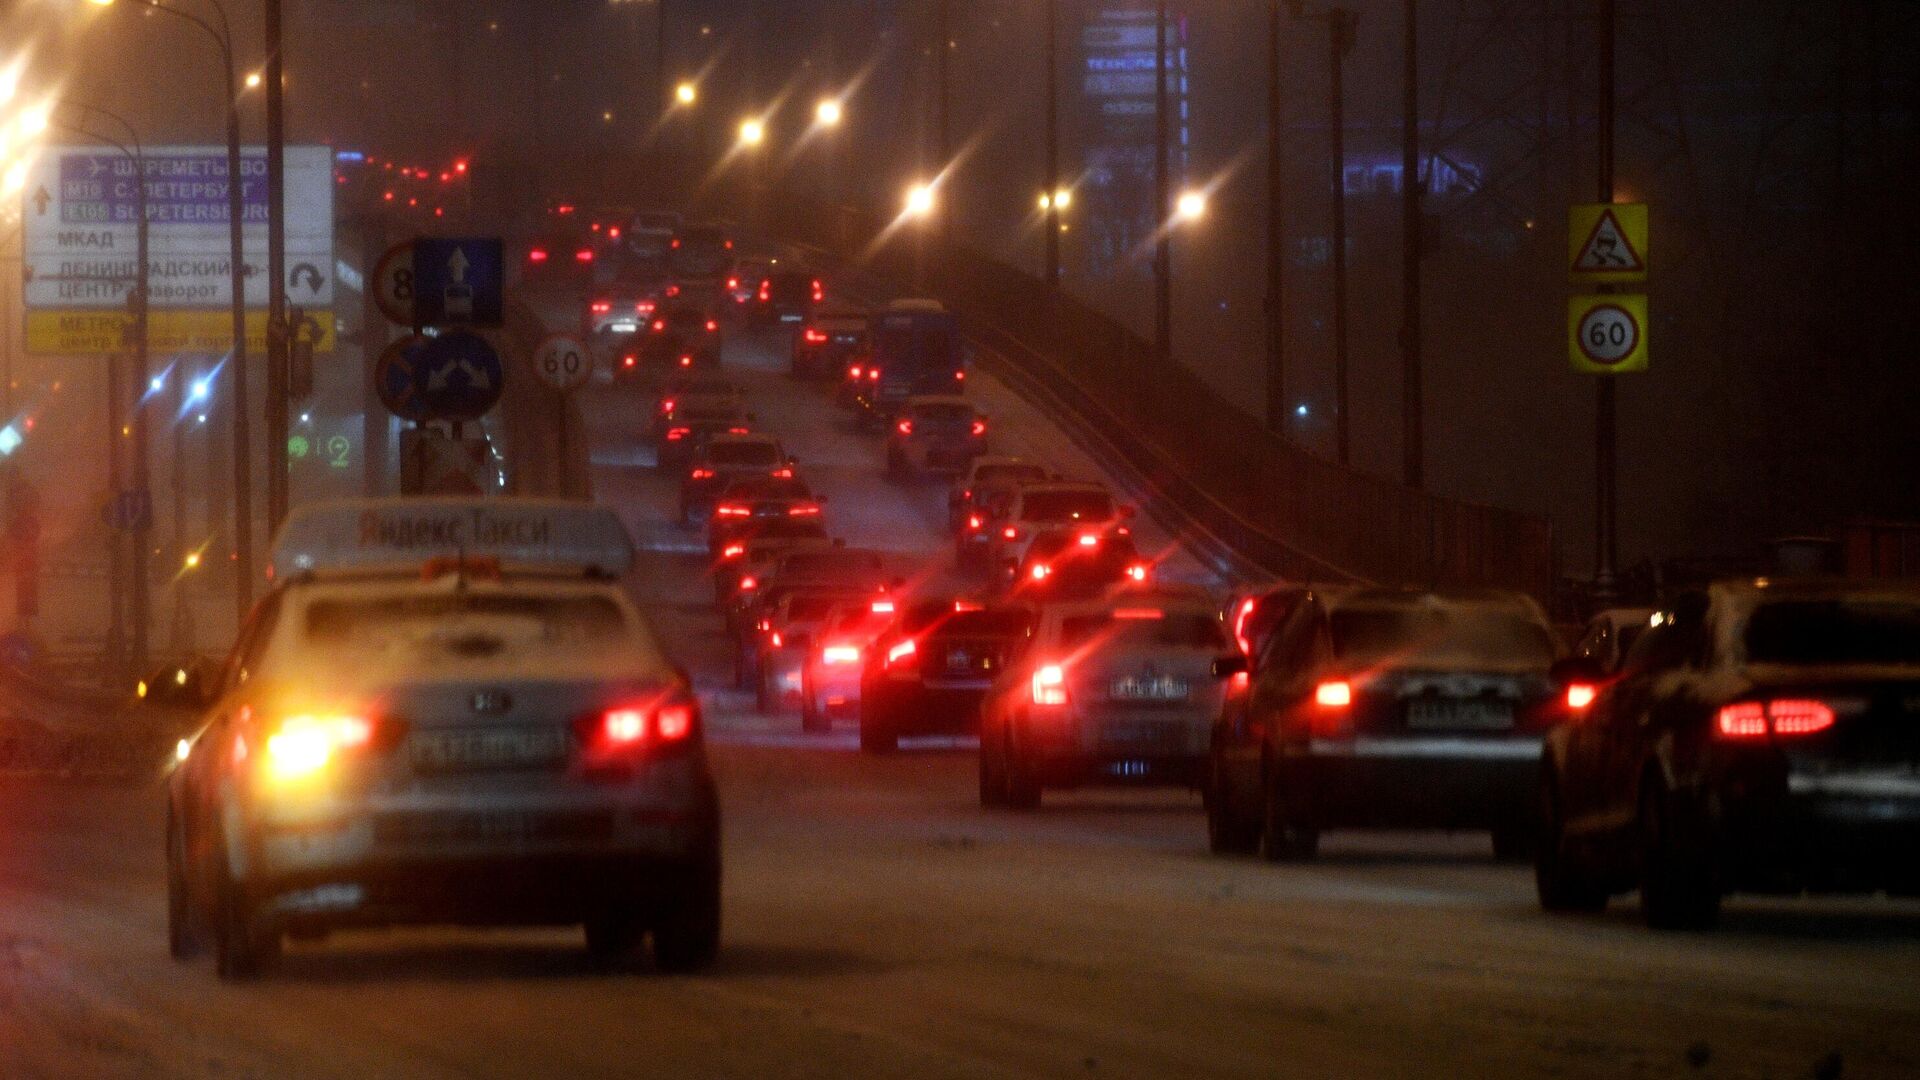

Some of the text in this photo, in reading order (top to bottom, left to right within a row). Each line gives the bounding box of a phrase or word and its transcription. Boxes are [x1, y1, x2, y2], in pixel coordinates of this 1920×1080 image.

[113, 159, 267, 177] ШРЕМЕТЬВО
[59, 259, 231, 278] ЛЕНИНГАДСКИЙ
[1590, 321, 1626, 347] 60
[544, 349, 580, 376] 60
